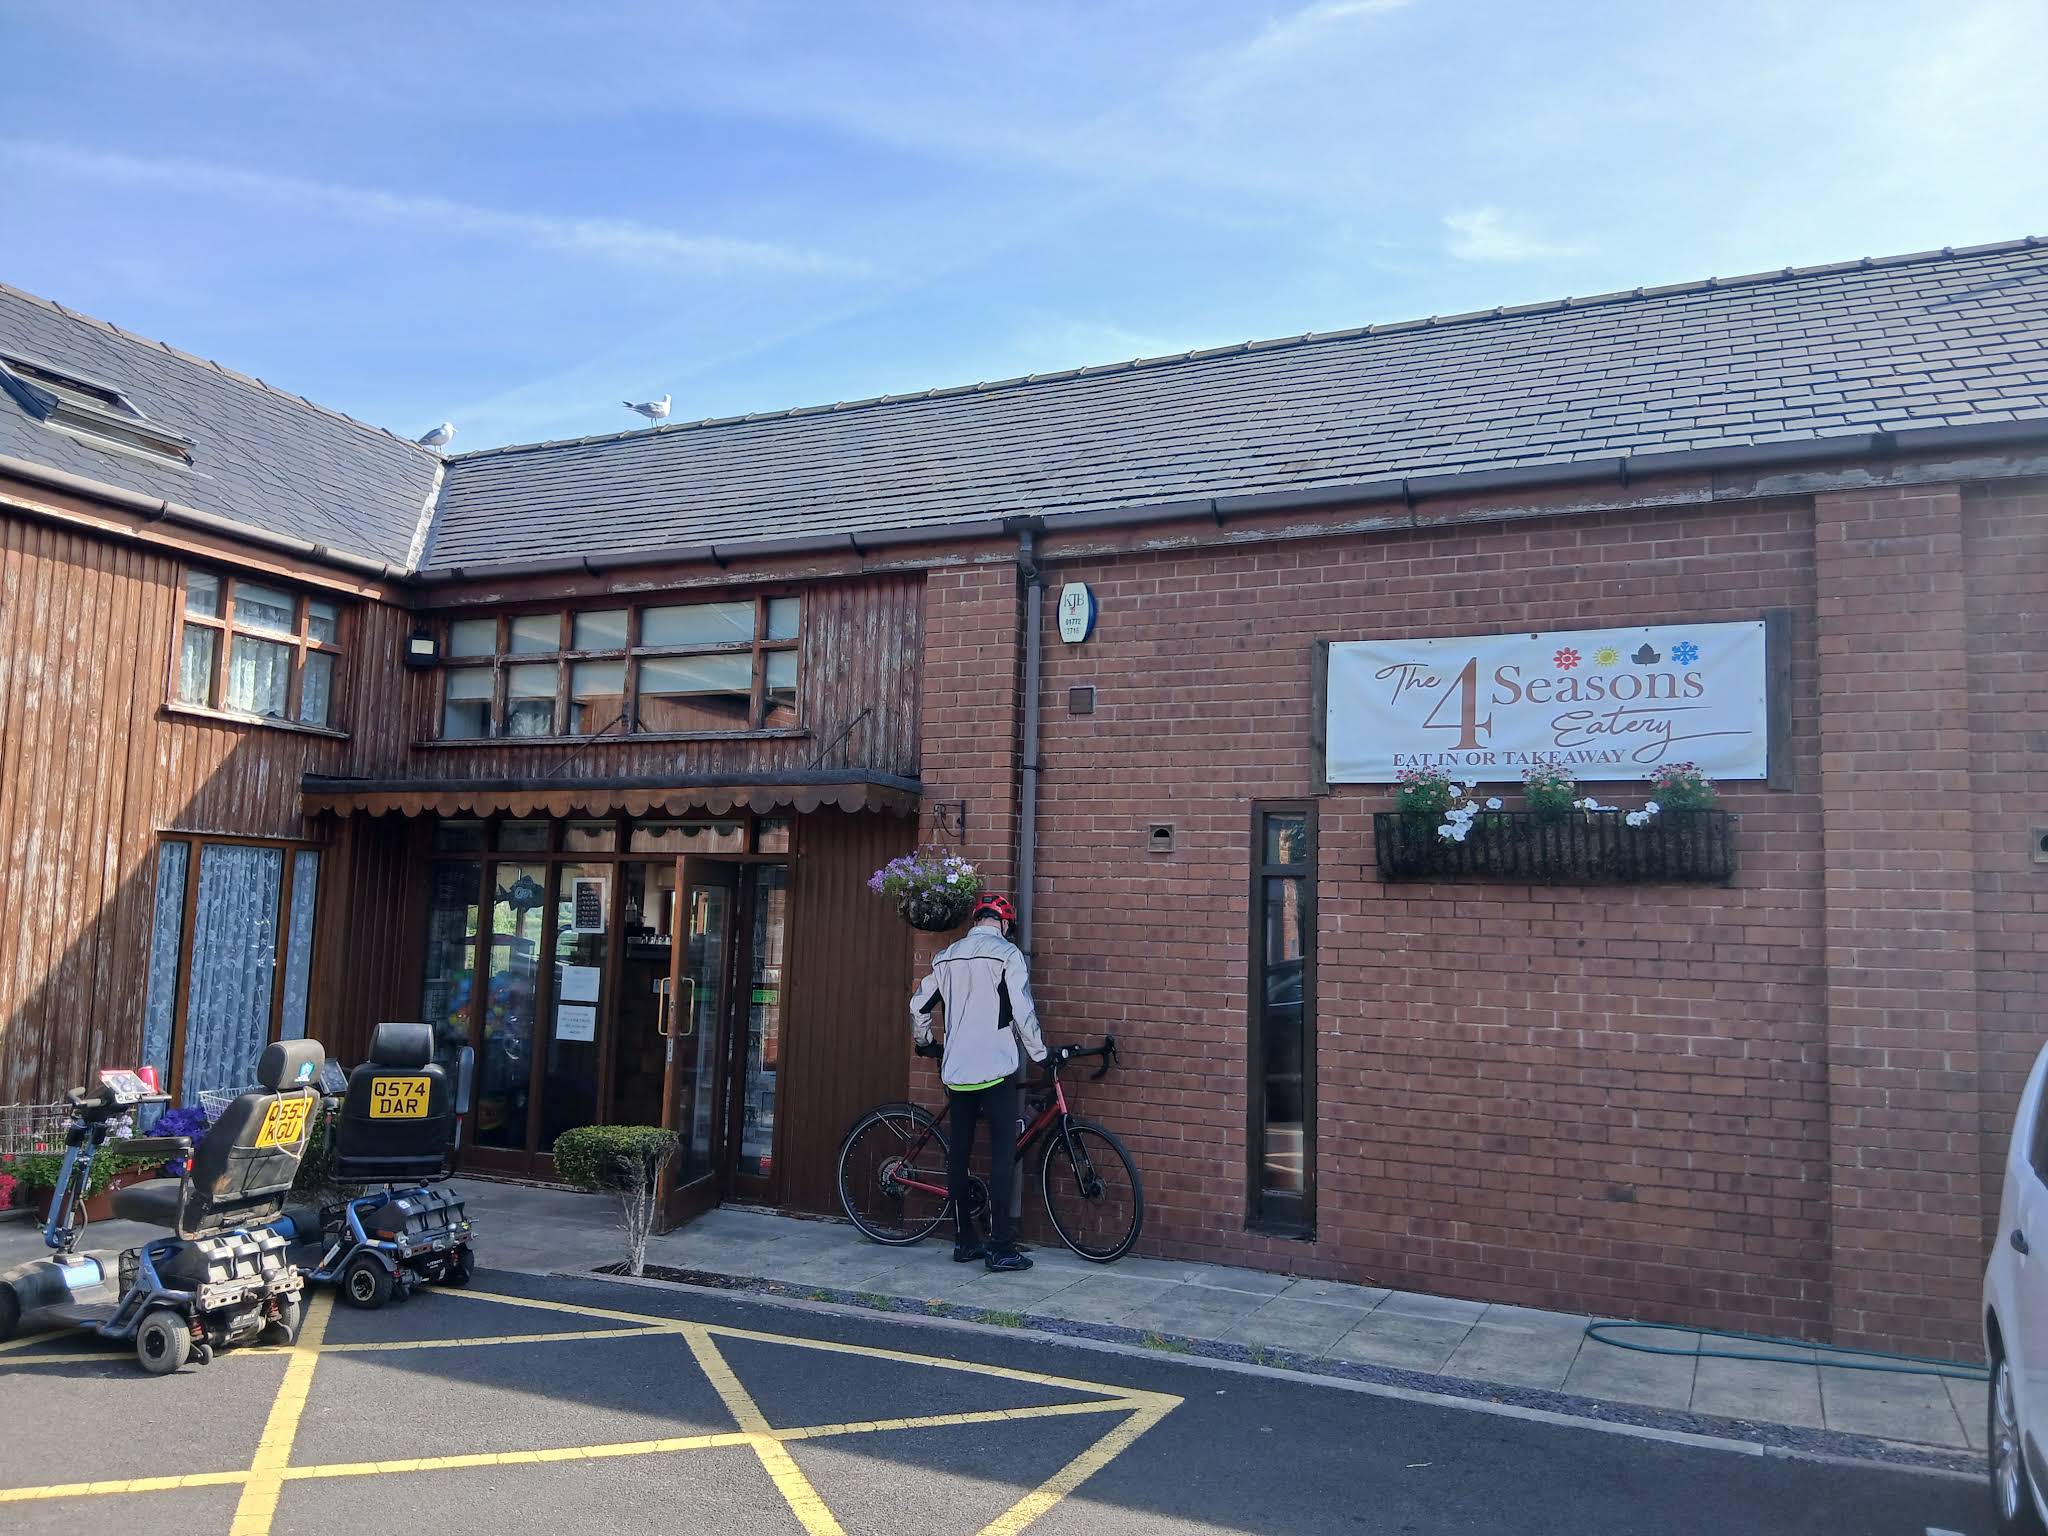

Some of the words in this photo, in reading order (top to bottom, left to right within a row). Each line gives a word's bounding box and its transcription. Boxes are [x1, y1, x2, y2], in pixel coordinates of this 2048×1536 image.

[1375, 663, 1441, 705] The
[1422, 656, 1492, 750] 4
[1492, 665, 1704, 705] Seasons
[1550, 706, 1752, 763] Eatery
[1392, 753, 1432, 767] EAT
[1438, 753, 1459, 766] IN
[1465, 752, 1496, 765] OR
[1502, 749, 1625, 765] TAKEAWAY
[374, 1082, 426, 1097] Q574
[380, 1099, 418, 1114] DAR
